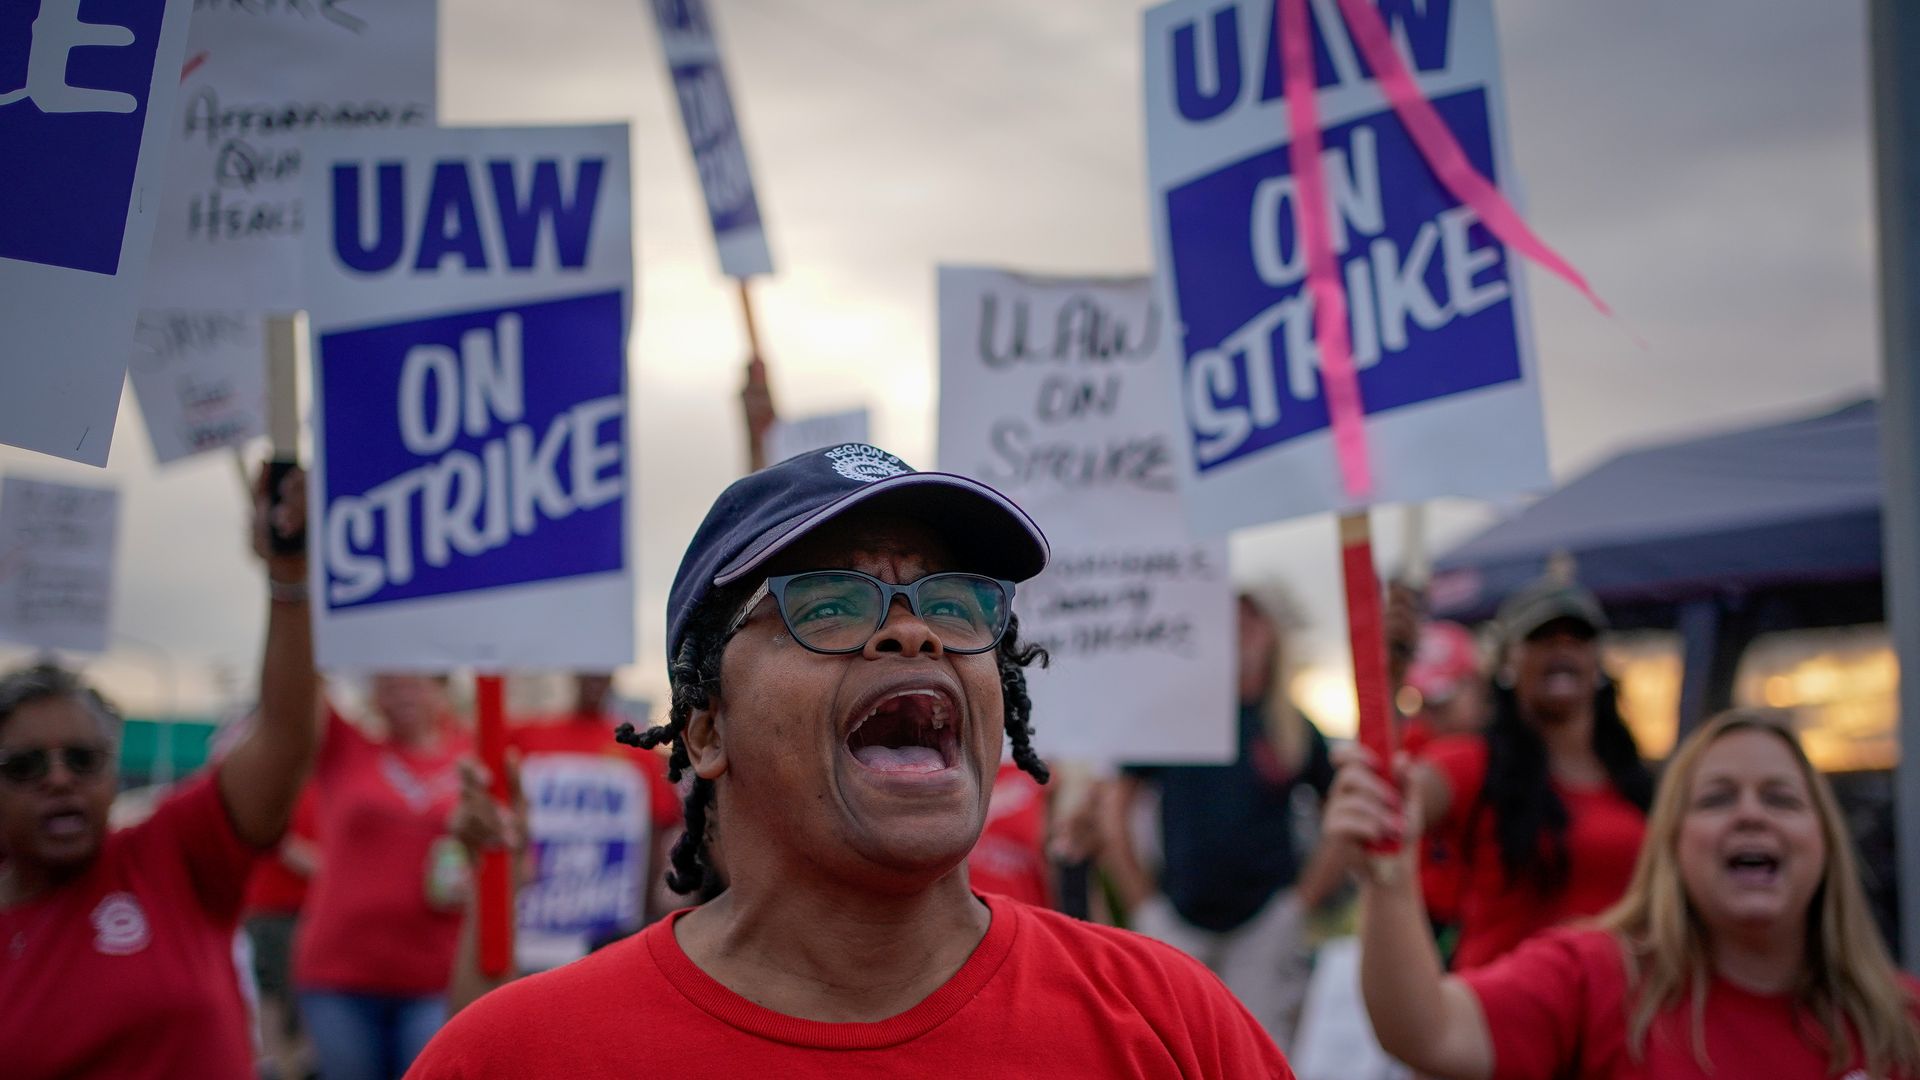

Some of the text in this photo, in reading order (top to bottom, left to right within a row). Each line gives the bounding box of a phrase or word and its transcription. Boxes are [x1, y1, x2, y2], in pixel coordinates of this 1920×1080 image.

[330, 158, 608, 274] UAW
[977, 291, 1160, 370] UAW
[398, 311, 525, 457] ON
[1034, 373, 1121, 424] ON
[326, 395, 625, 604] STRIKE
[824, 444, 884, 460] REGION
